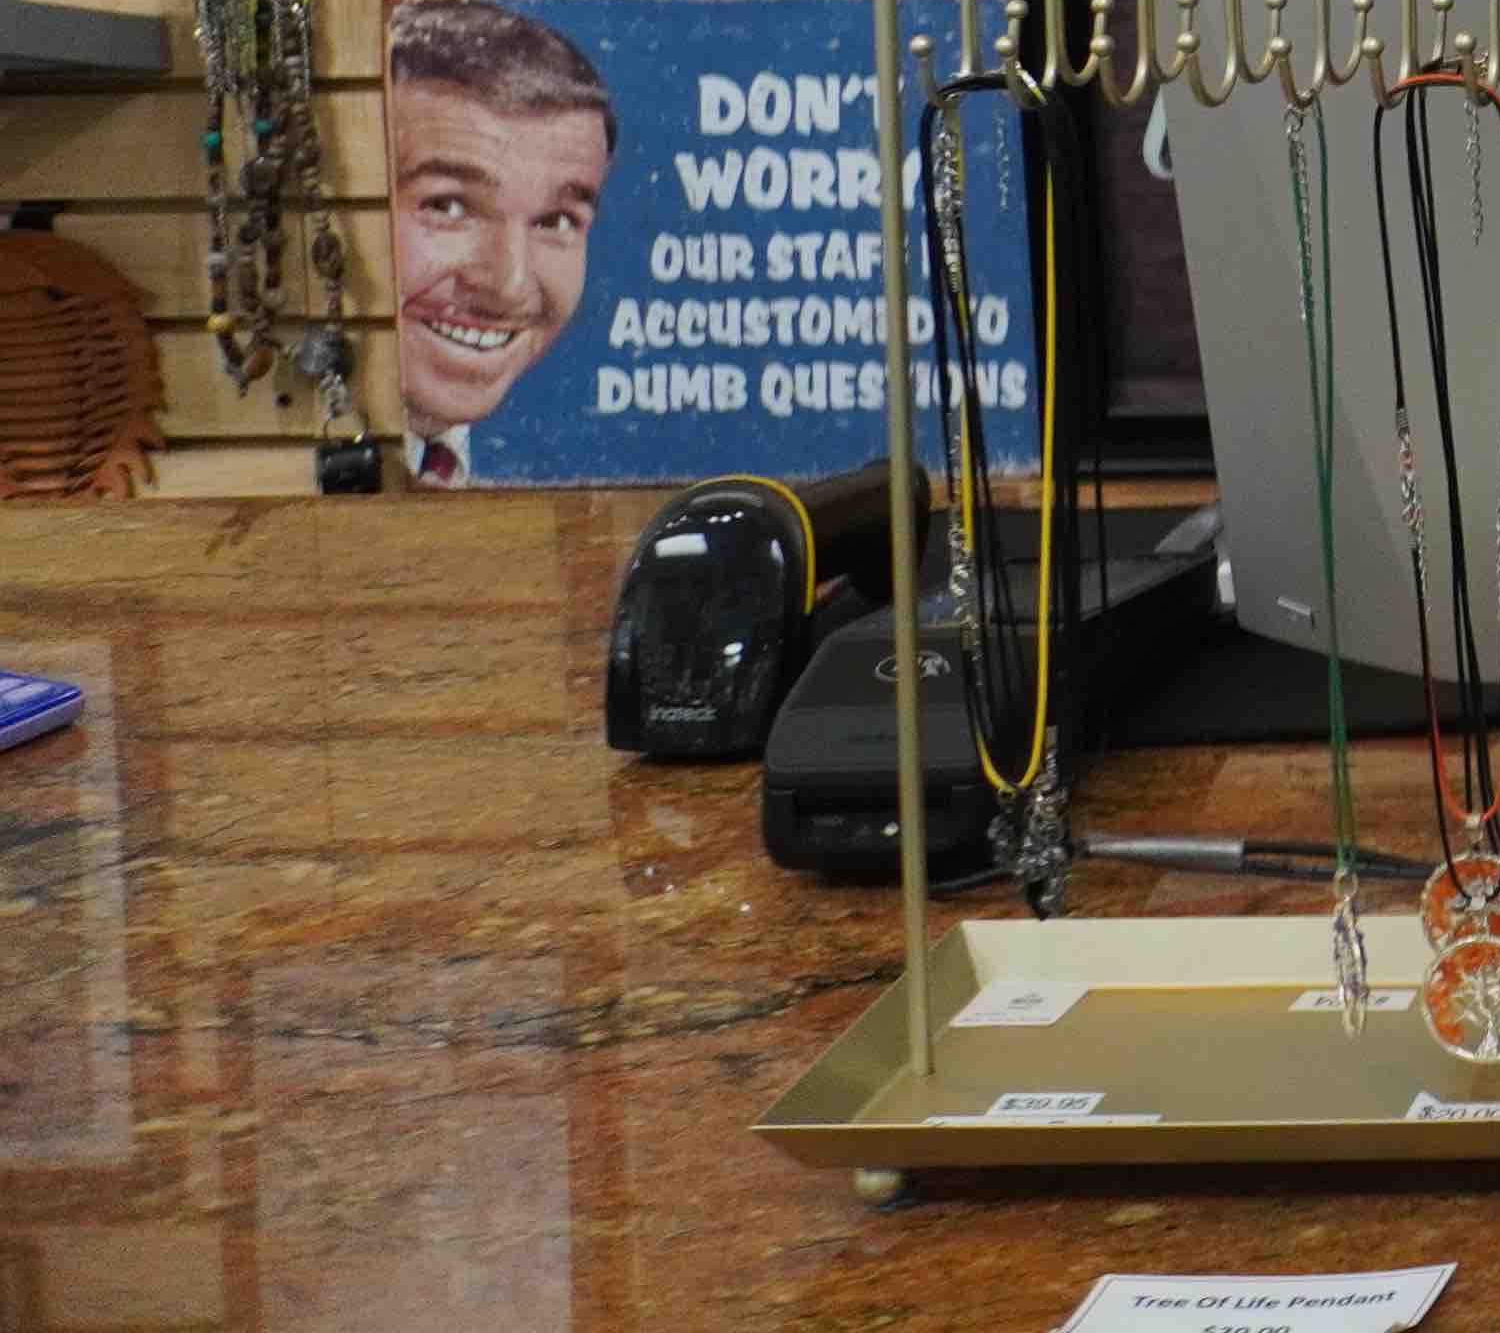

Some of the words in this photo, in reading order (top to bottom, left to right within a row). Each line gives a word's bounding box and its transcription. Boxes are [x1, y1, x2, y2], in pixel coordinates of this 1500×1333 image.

[699, 71, 905, 136] DON'T
[673, 146, 923, 213] WORRY
[650, 231, 755, 284] OUR
[766, 230, 911, 282] STAF
[597, 361, 748, 416] DUMB
[760, 359, 1028, 418] QUESIONS
[1131, 1294, 1190, 1310] Tree
[1198, 1293, 1228, 1310] Of
[1234, 1294, 1281, 1311] Life
[1287, 1289, 1400, 1310] Pendant
